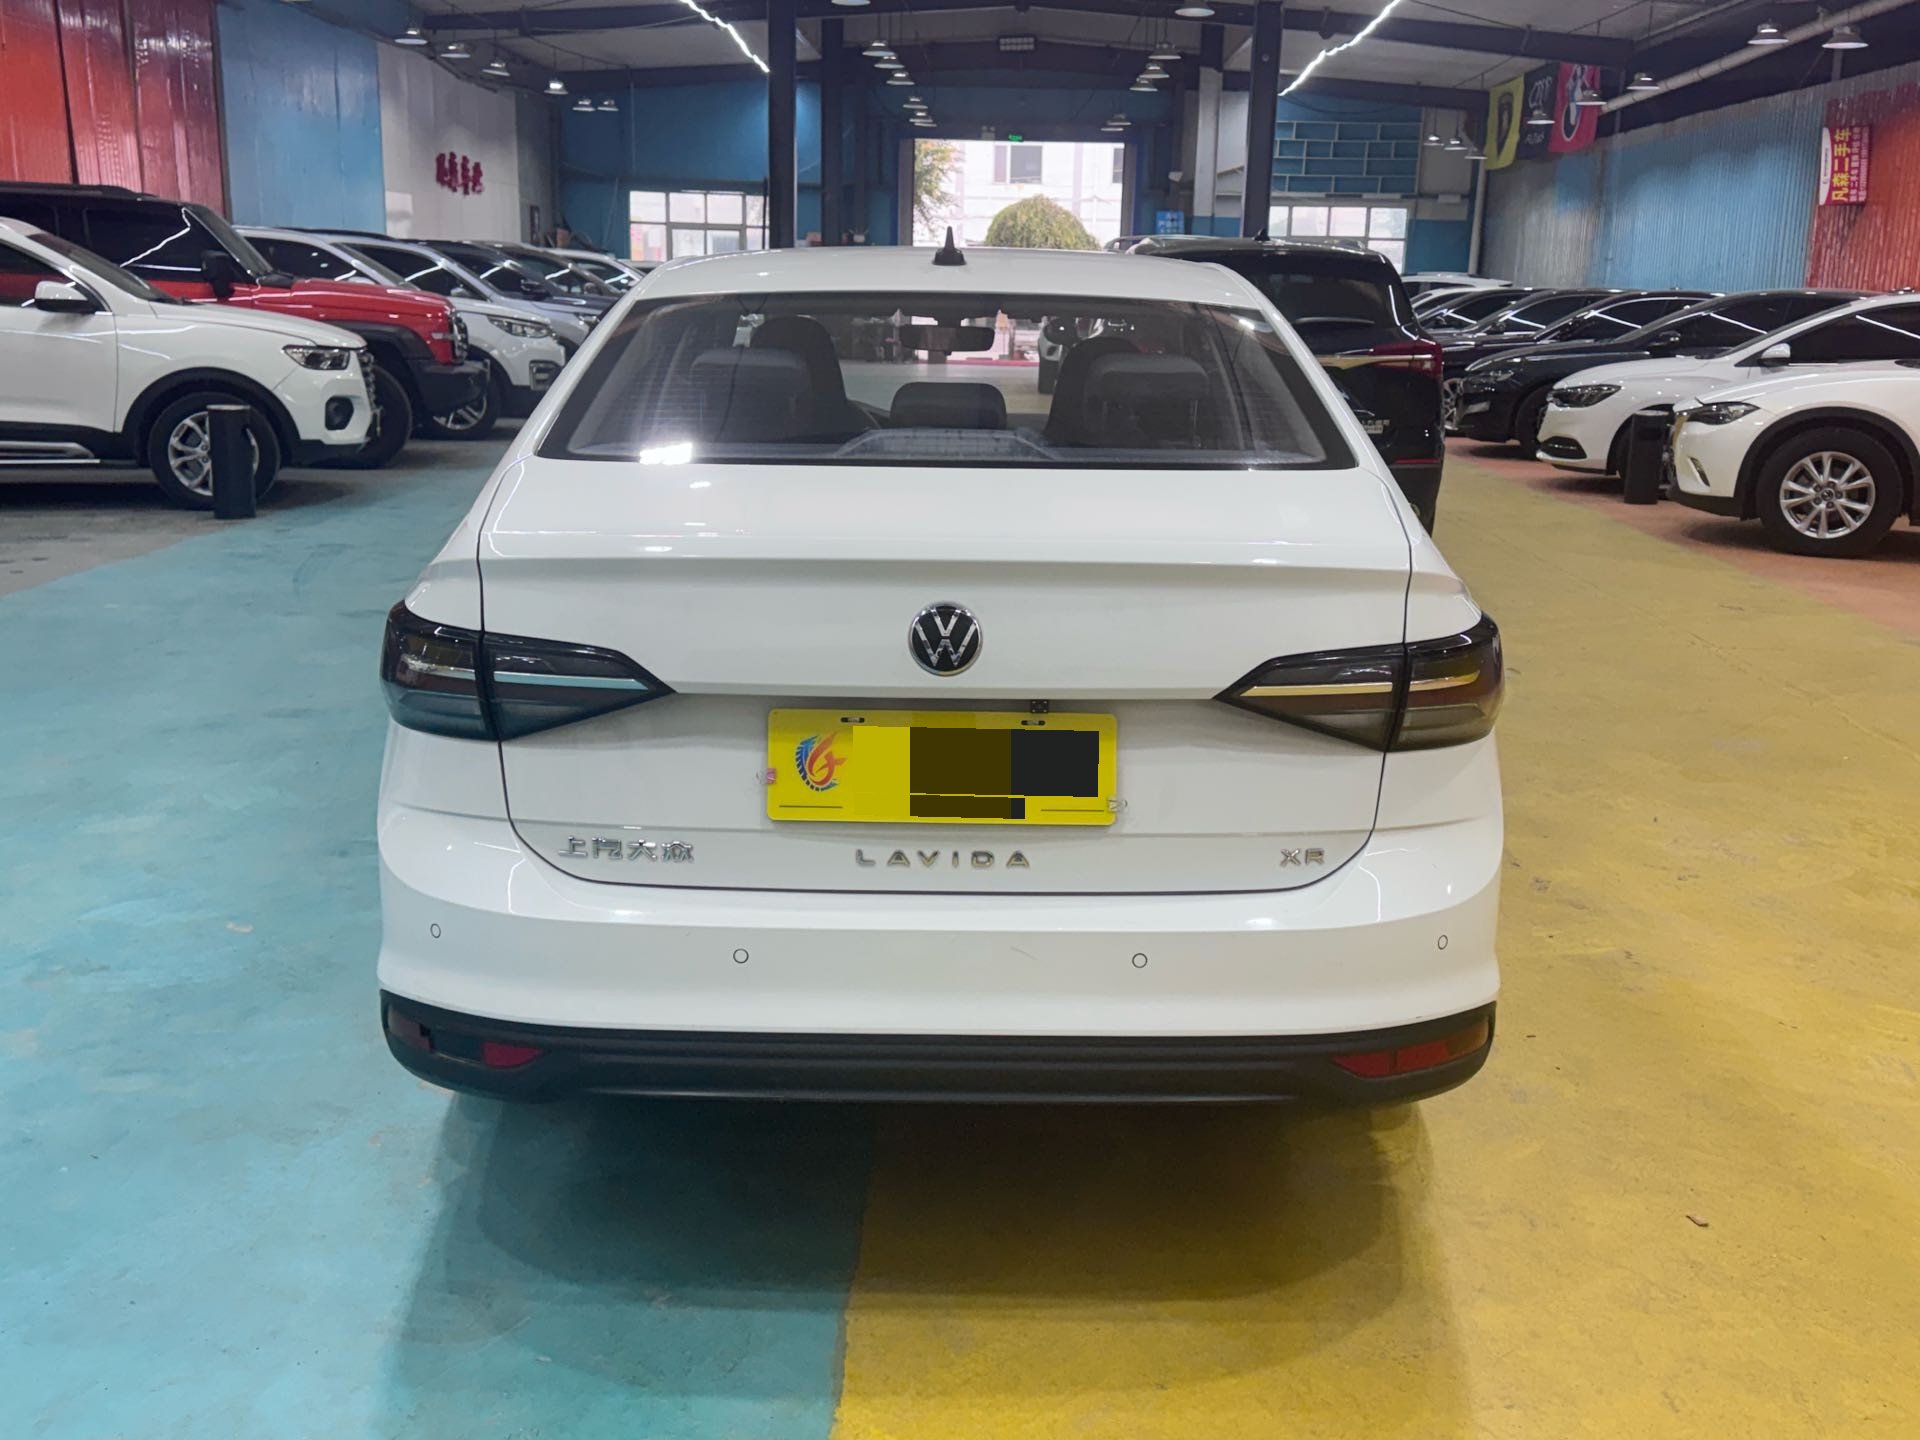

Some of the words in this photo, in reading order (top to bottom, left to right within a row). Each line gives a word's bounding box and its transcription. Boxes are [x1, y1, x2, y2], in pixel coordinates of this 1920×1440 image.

[558, 835, 694, 863] 上汽大众
[855, 849, 1031, 868] LAVIDA
[1279, 848, 1326, 867] XR
